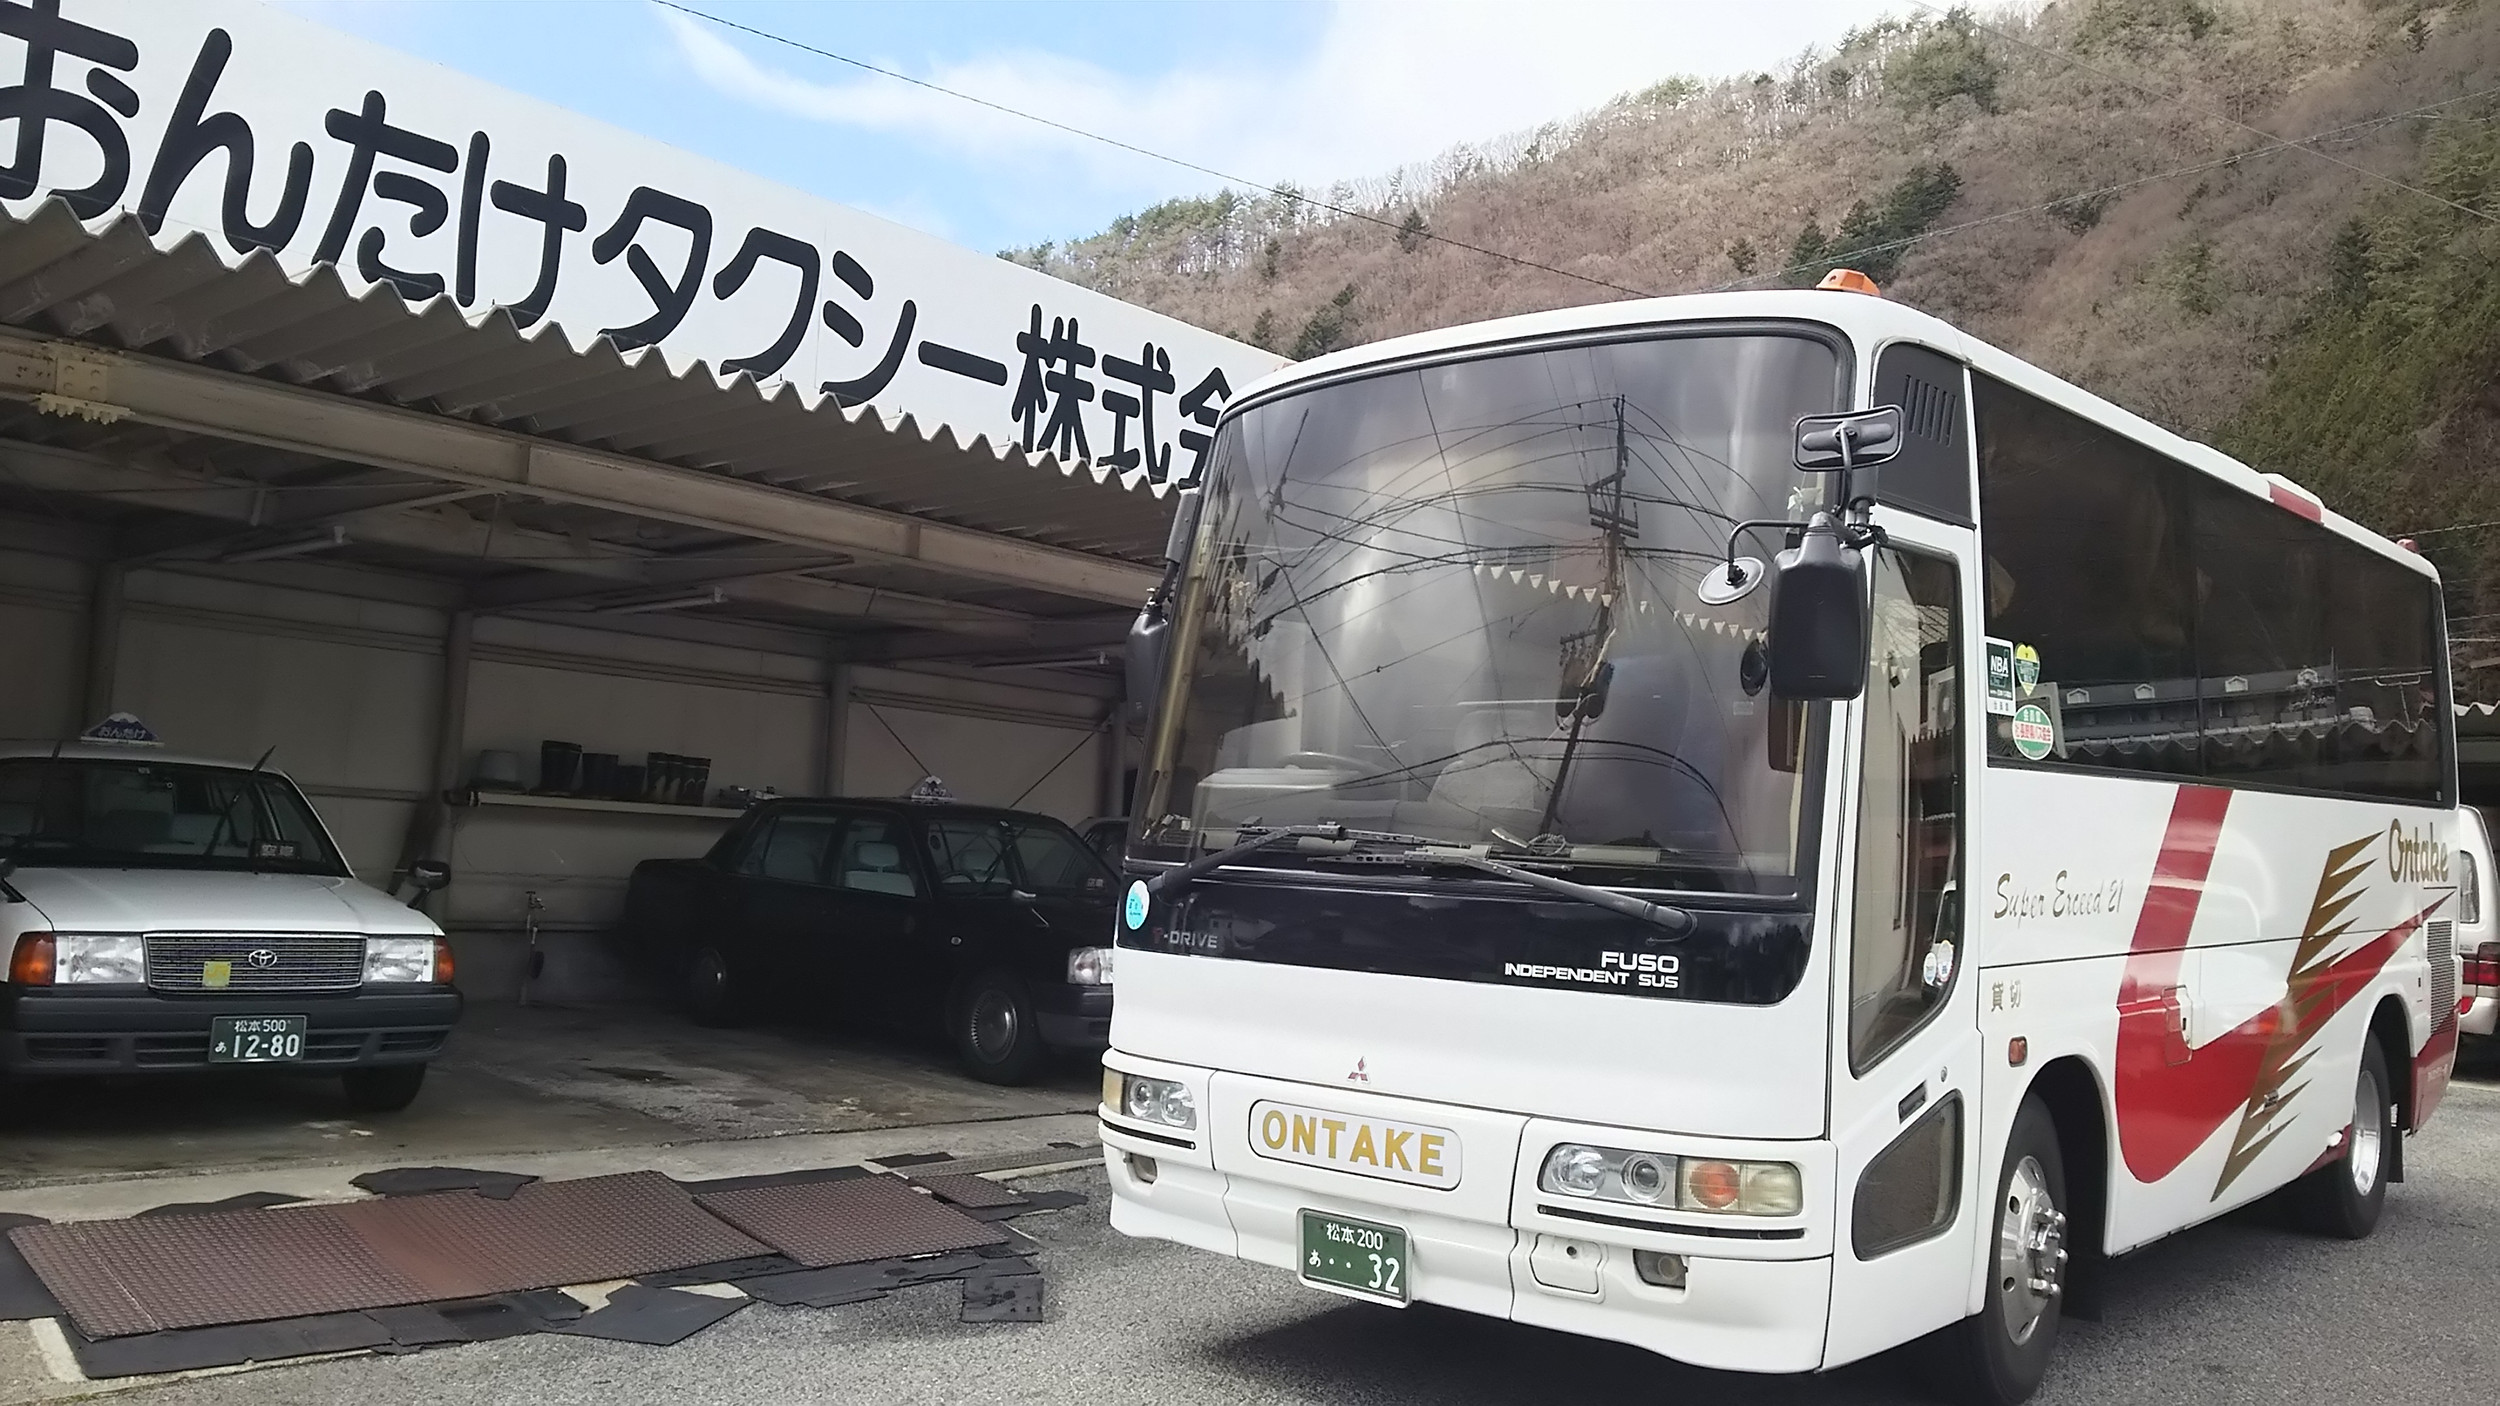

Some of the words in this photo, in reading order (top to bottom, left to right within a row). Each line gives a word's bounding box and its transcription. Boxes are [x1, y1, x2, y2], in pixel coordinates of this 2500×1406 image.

[1990, 654, 2009, 675] NBA
[98, 726, 146, 740] おんたけ
[2389, 818, 2449, 884] Ontake
[1994, 872, 2045, 929] Super
[2053, 870, 2104, 918] Exceed
[1152, 927, 1218, 949] T-DRIVE
[1601, 951, 1679, 974] FUSO
[1505, 962, 1630, 985] INDEPENDENT
[1638, 973, 1679, 989] SUS
[214, 1041, 227, 1054] あ
[233, 1034, 300, 1058] 12-80
[1262, 1109, 1445, 1177] ONTAKE
[1309, 1249, 1321, 1268] あ
[1368, 1253, 1400, 1294] 32
